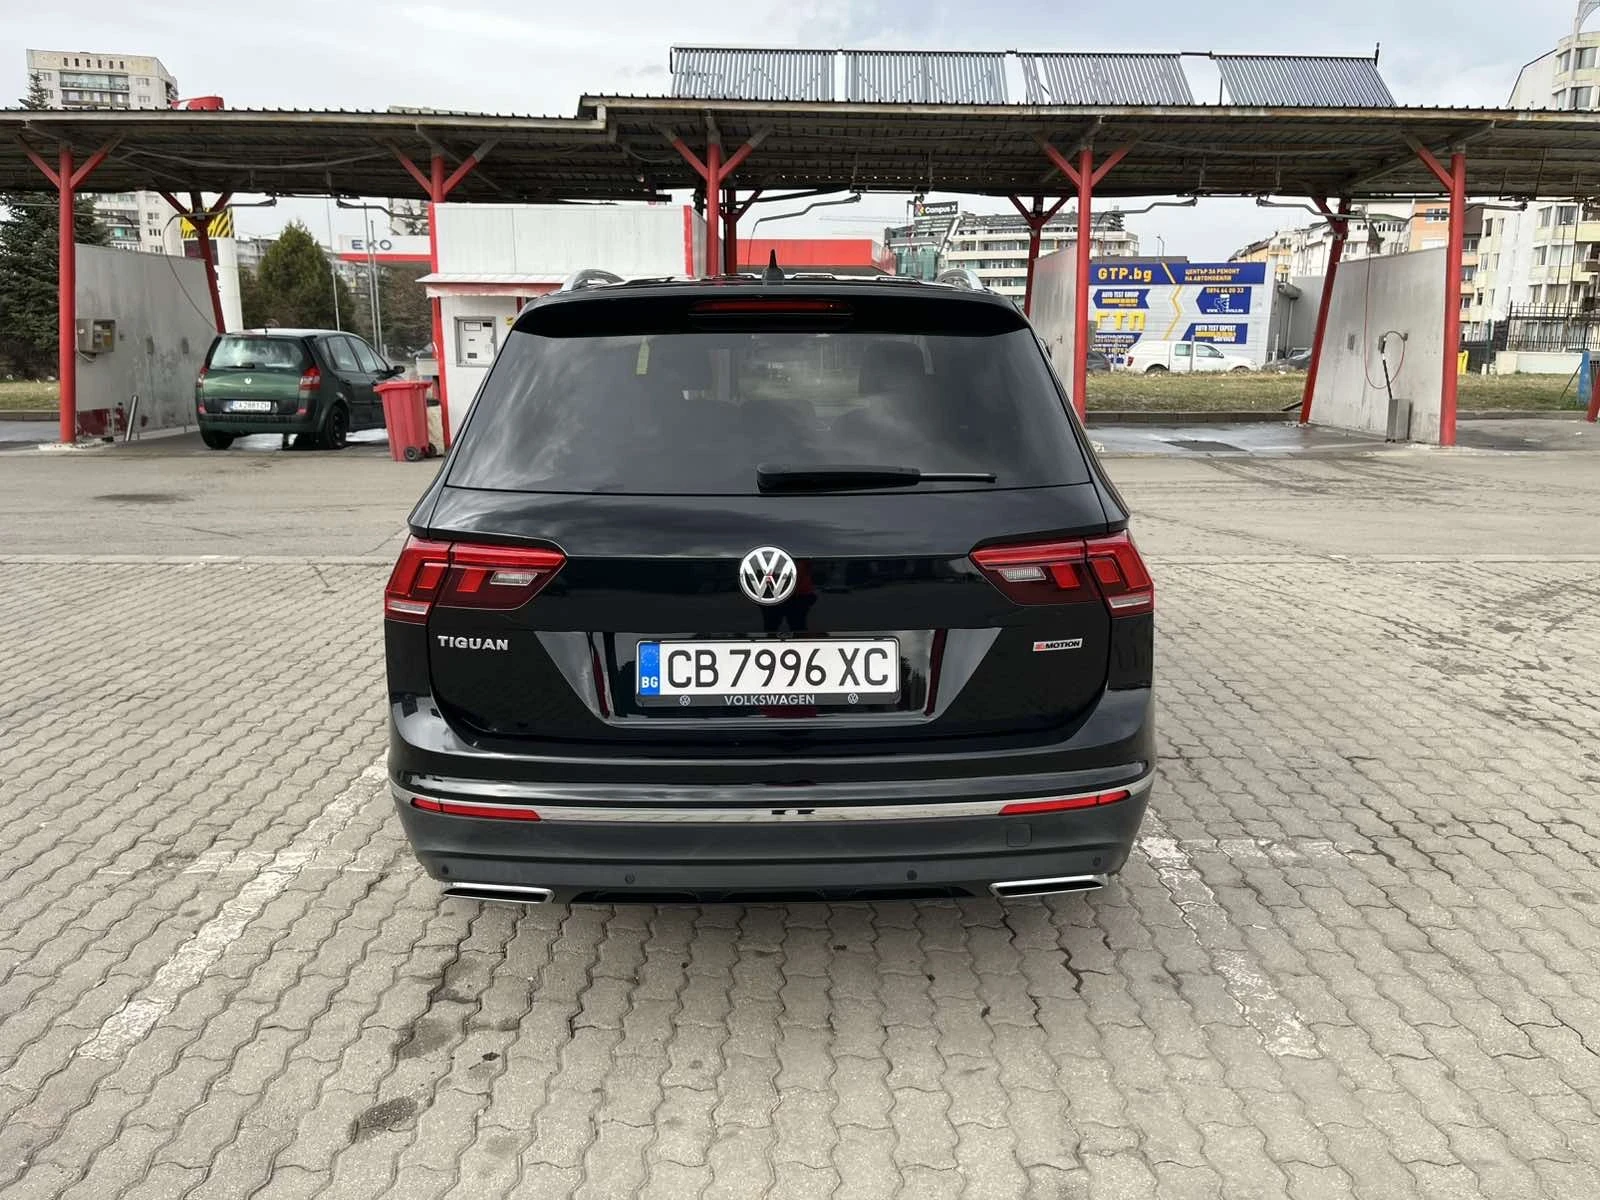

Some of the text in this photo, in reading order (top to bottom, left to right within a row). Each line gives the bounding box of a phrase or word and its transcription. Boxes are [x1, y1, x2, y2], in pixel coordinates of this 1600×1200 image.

[1098, 267, 1152, 283] GTP.bg
[1096, 311, 1146, 331] ГТП
[437, 635, 509, 651] TIGUAN
[641, 647, 889, 689] BG CB 7996 XC
[724, 694, 816, 706] VOLKSWAGEN
